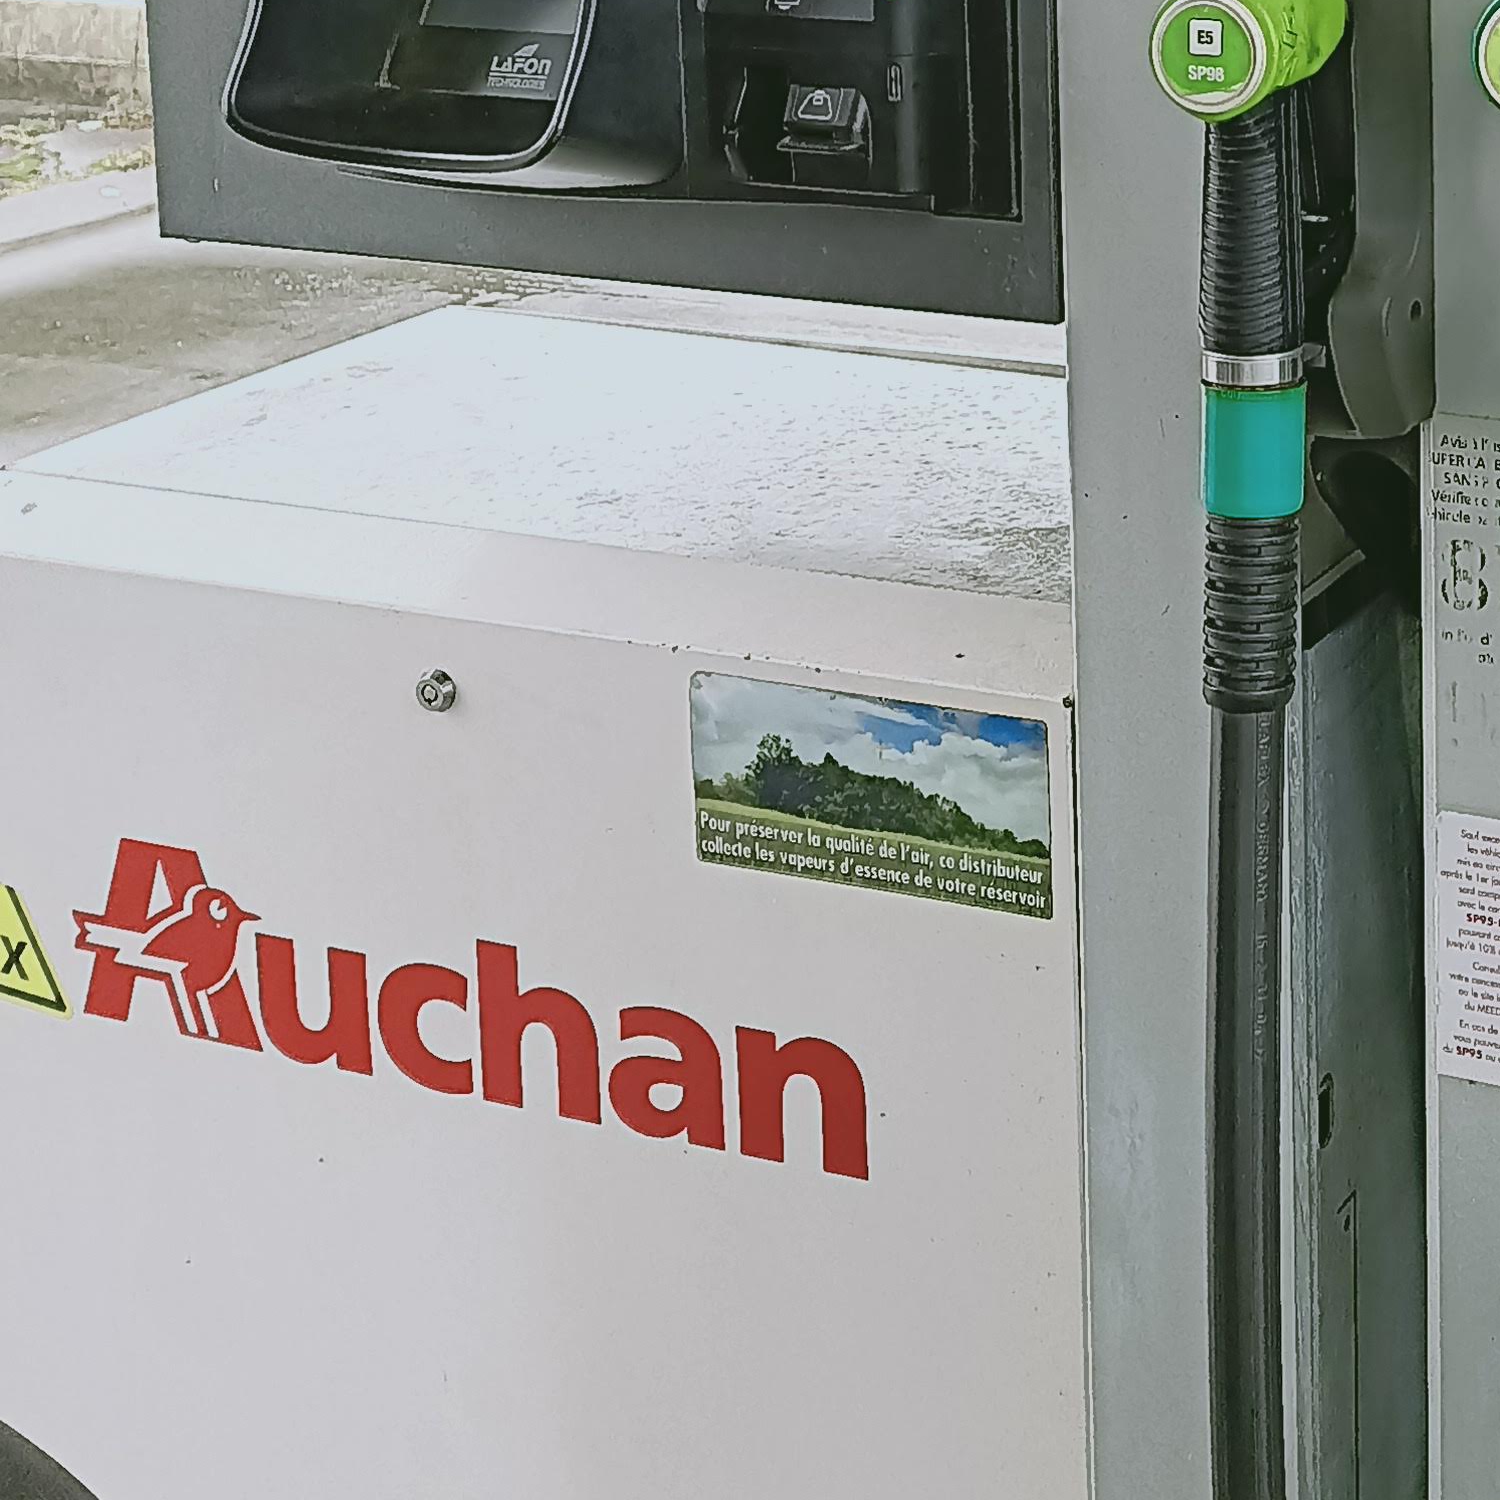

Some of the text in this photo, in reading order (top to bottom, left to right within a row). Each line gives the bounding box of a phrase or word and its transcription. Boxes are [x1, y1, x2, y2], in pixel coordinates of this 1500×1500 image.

[1187, 64, 1225, 82] SP98
[1197, 30, 1213, 45] E5
[700, 810, 731, 833] Pour
[735, 819, 804, 845] préserver
[807, 828, 821, 848] la
[825, 834, 875, 856] qualité
[878, 839, 897, 860] de
[900, 842, 934, 870] l'air,
[958, 852, 1044, 885] distributeur
[701, 836, 1047, 909] collecte les vapeurs d'essence de votre réservoir
[72, 837, 870, 1181] Auchan
